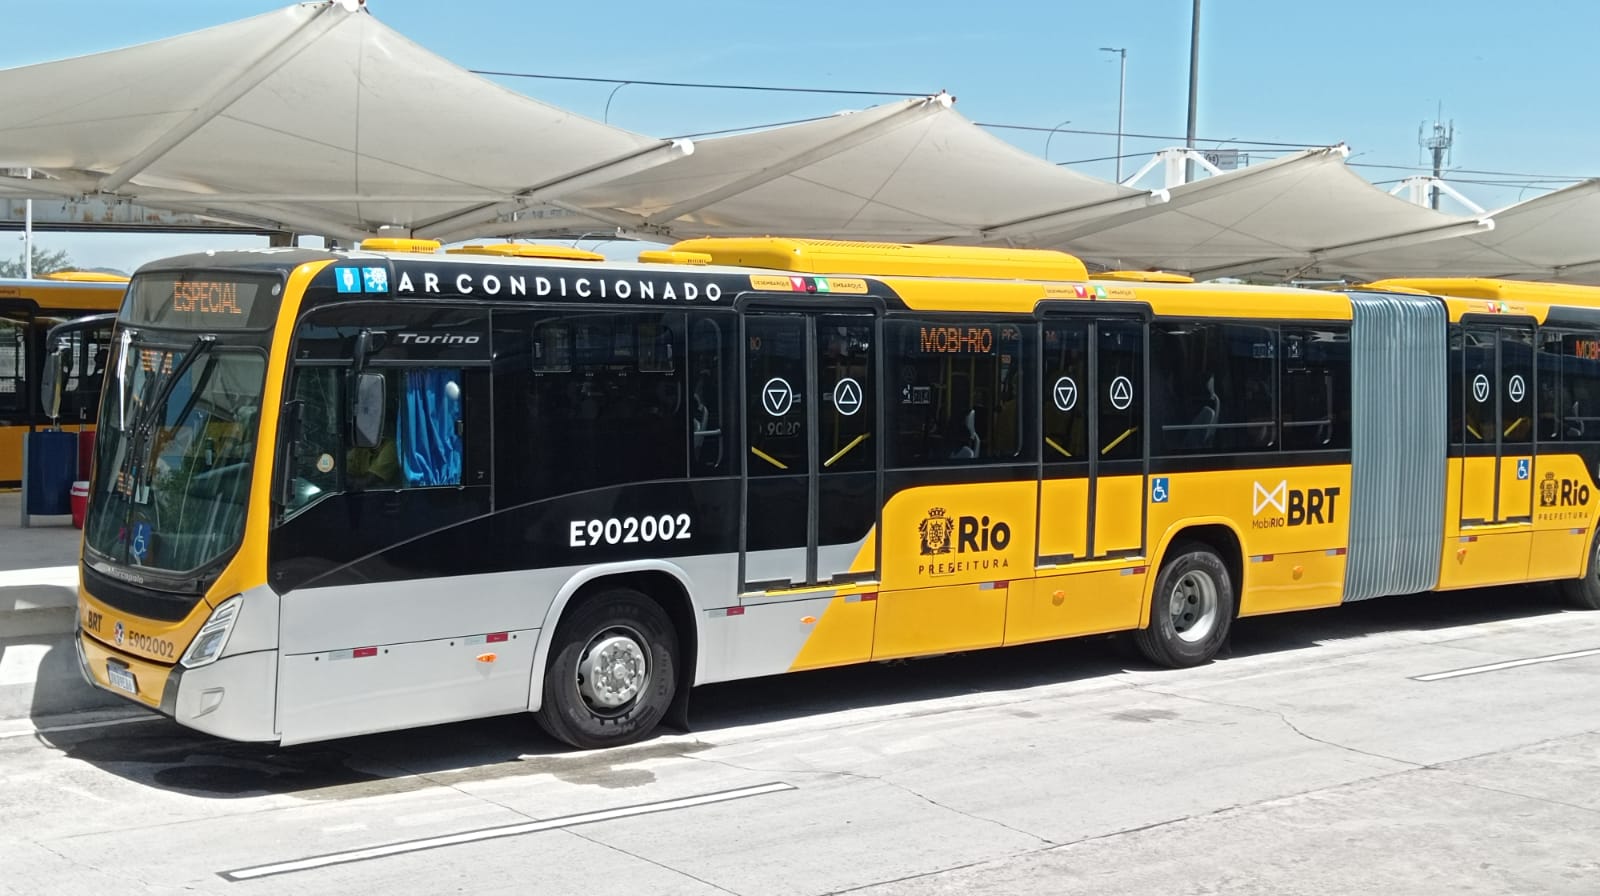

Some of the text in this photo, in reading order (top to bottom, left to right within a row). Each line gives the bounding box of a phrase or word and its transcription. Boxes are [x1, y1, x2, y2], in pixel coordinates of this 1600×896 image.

[173, 281, 242, 314] ESPECIAL
[398, 272, 722, 301] AR CONDICIONADO
[398, 333, 480, 344] Torino
[920, 327, 993, 353] MOBI-RIO
[1561, 479, 1590, 506] Rio
[1287, 487, 1340, 526] BRT
[1538, 512, 1588, 520] PREFEITURA
[570, 513, 692, 547] E902002
[958, 516, 1011, 553] Rio
[1252, 518, 1284, 528] MobiRIO
[918, 559, 1009, 575] PREFEITURA
[88, 610, 103, 633] BRT
[128, 630, 175, 658] E902002
